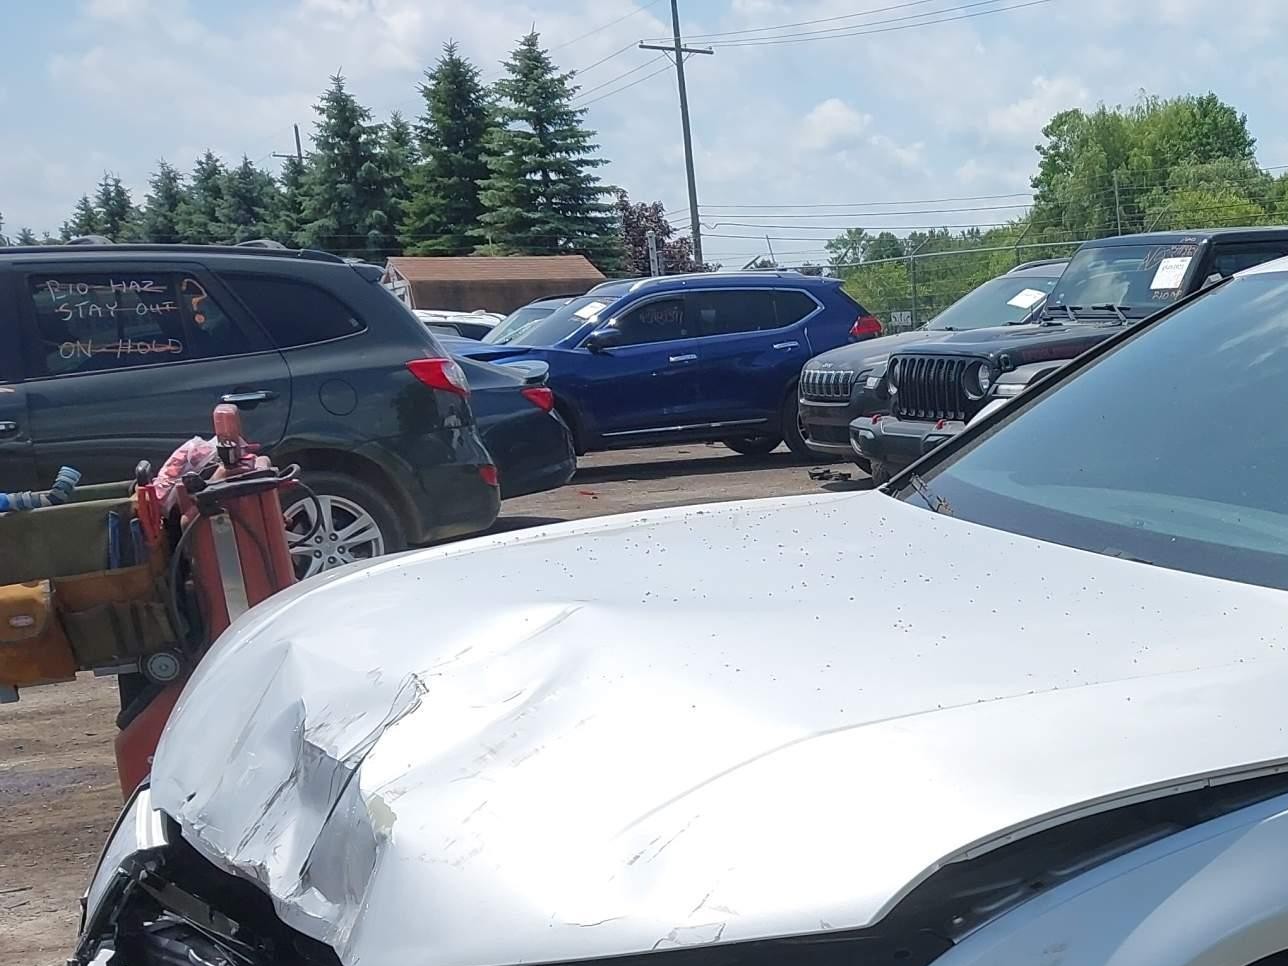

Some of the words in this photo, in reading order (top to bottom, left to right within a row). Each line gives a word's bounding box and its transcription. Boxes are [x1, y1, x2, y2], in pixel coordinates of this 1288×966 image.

[56, 301, 118, 320] STAY
[60, 340, 92, 358] ON
[117, 338, 183, 358] HOLD
